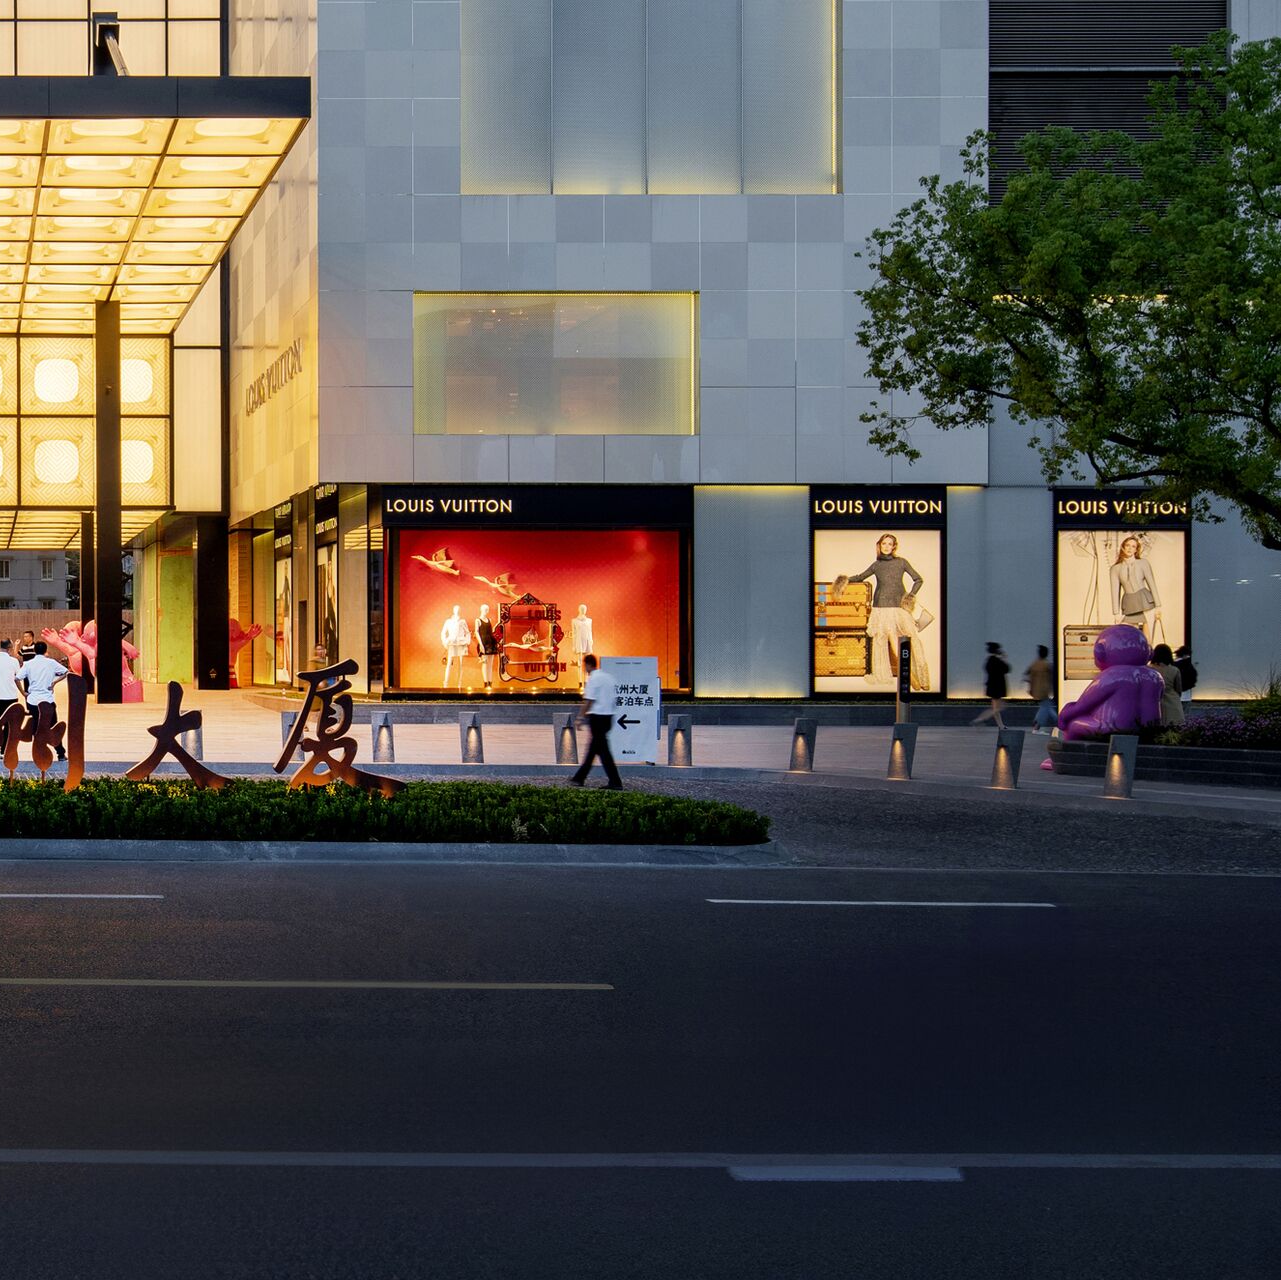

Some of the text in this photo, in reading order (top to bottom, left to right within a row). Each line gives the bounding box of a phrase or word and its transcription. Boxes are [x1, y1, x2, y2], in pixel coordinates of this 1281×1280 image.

[386, 499, 513, 513] LOUIS VUITTON
[815, 500, 942, 514] LOUIS VUITTON
[1058, 500, 1187, 515] LOUIS VUITTON
